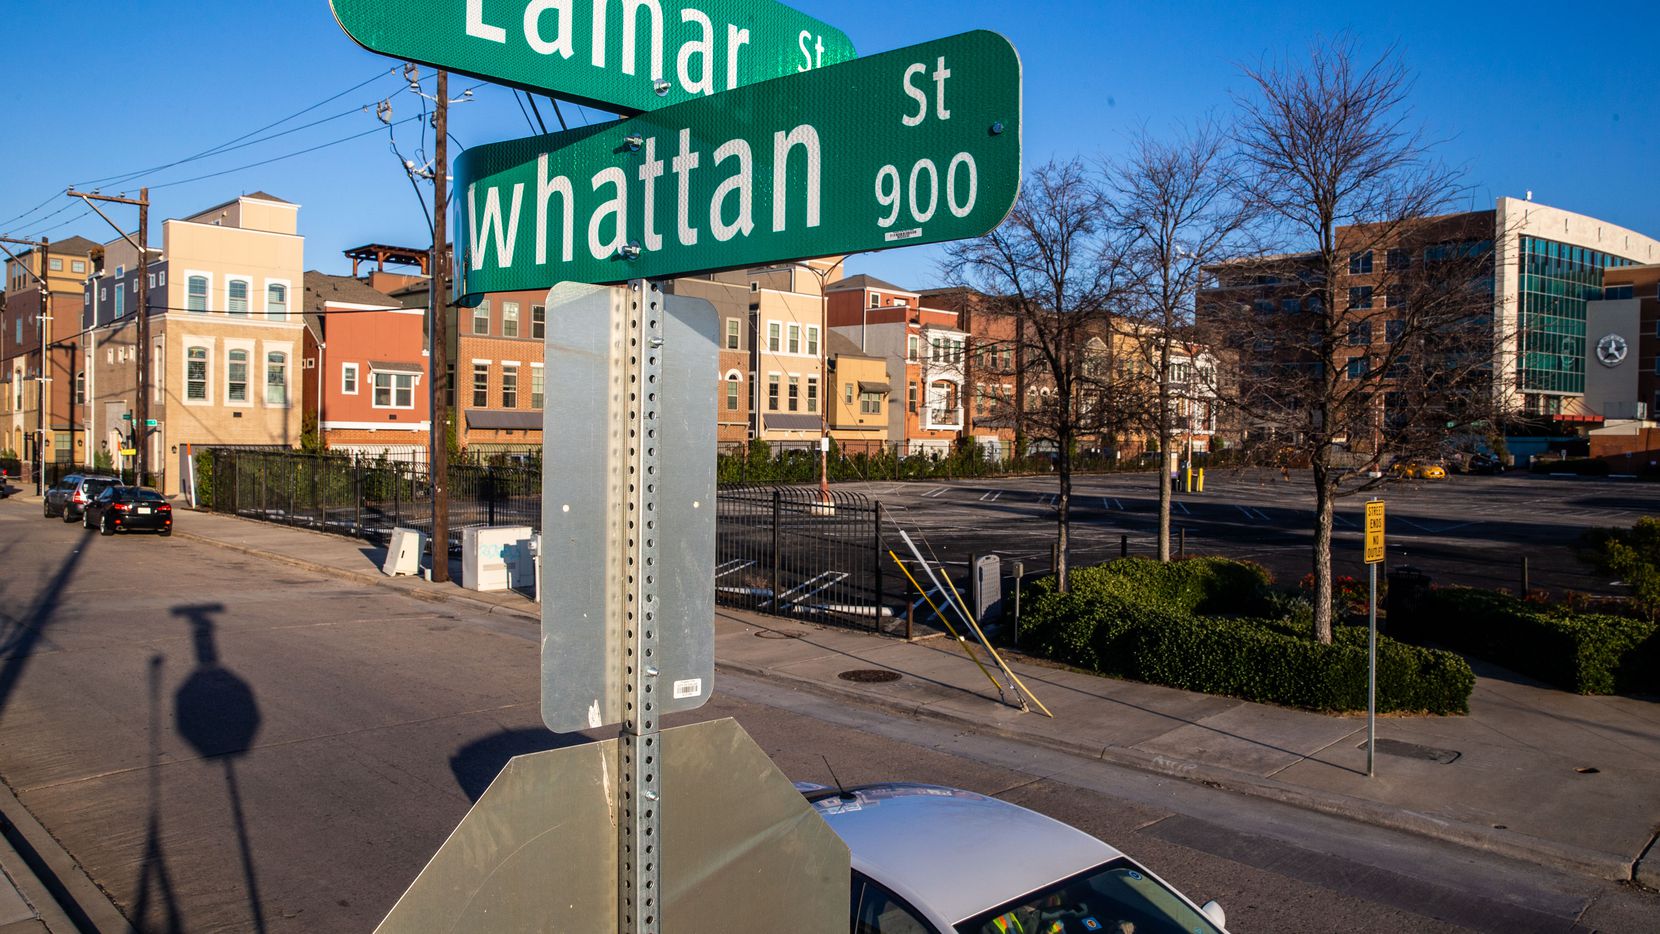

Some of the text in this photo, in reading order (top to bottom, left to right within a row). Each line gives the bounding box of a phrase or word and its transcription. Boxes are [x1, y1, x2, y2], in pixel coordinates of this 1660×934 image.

[797, 30, 825, 73] St
[902, 56, 952, 127] St
[875, 151, 978, 229] 900
